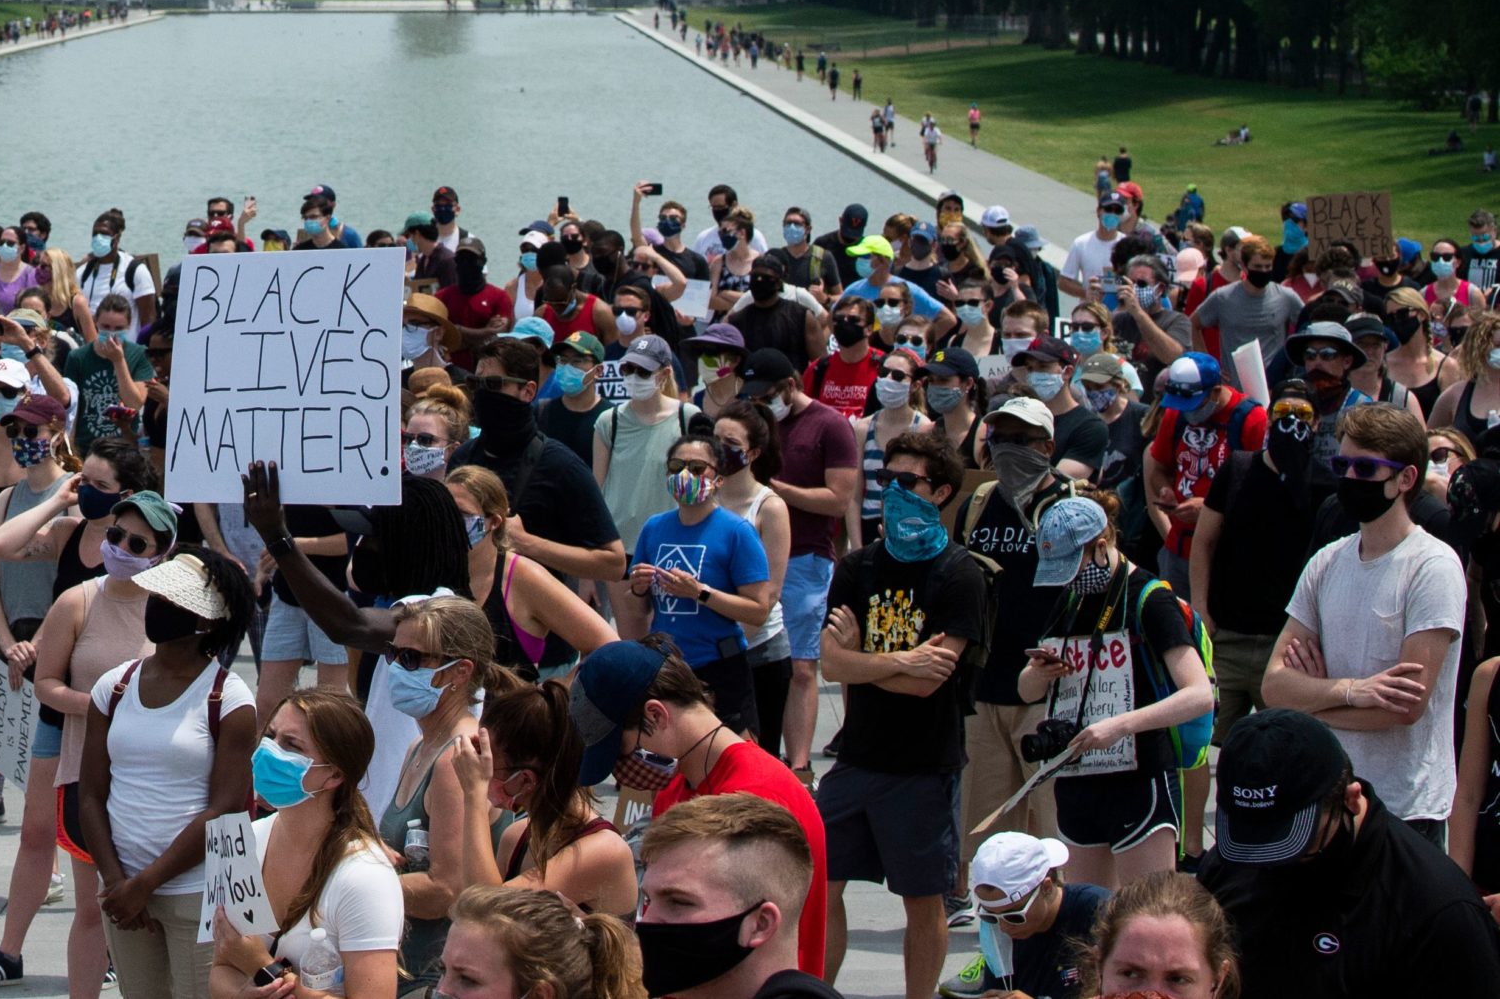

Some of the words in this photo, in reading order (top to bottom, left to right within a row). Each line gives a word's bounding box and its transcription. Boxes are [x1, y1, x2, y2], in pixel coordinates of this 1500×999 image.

[1312, 193, 1382, 224] BLACK
[1314, 217, 1384, 240] LIVES
[1315, 235, 1390, 259] MTER
[187, 263, 371, 333] BLACK
[204, 328, 391, 400] LIVES
[170, 405, 390, 480] MATTER!
[969, 527, 1036, 545] SOLDIE
[982, 543, 997, 552] OF
[1000, 543, 1029, 553] LOVE
[1098, 605, 1113, 631] Nikon
[14, 688, 33, 784] PANDEMIC
[1233, 785, 1278, 799] SONY
[207, 826, 219, 854] We
[225, 864, 261, 905] You.
